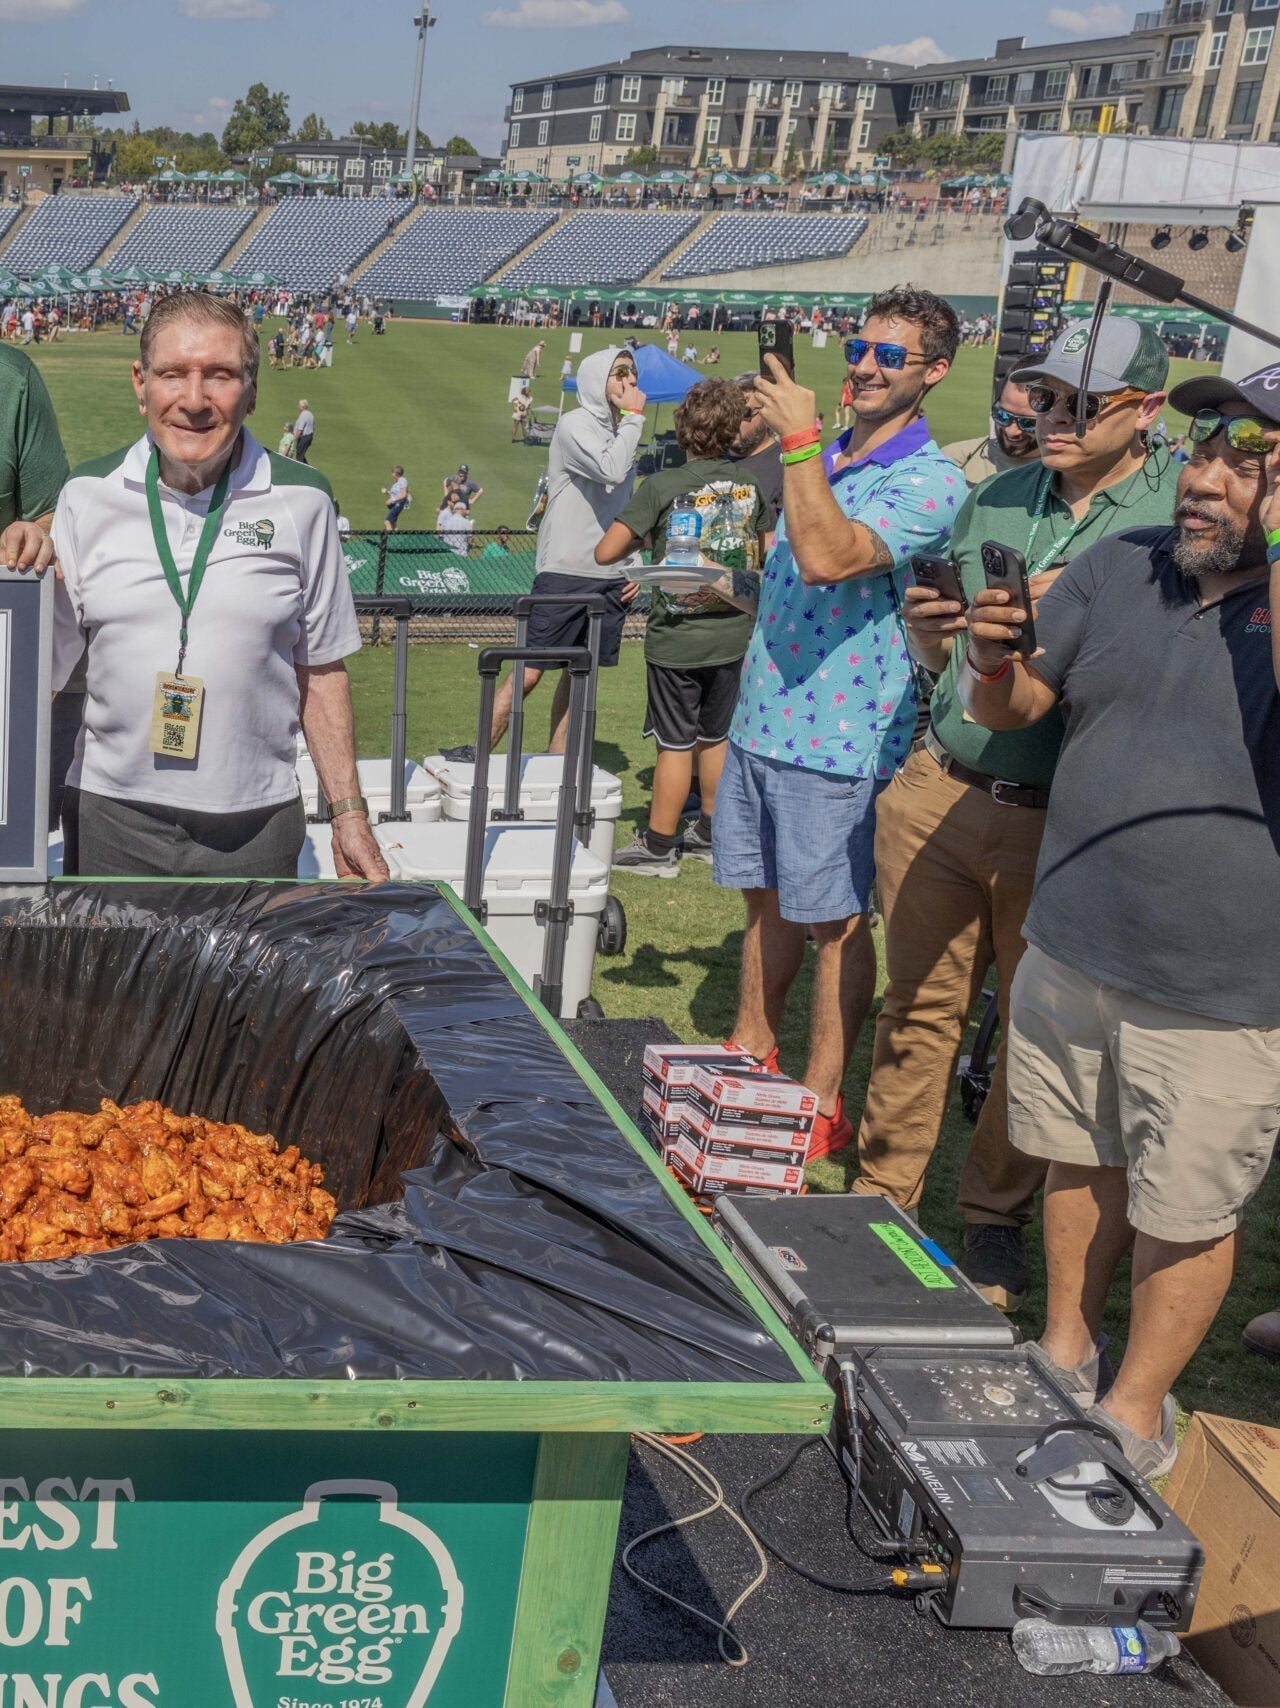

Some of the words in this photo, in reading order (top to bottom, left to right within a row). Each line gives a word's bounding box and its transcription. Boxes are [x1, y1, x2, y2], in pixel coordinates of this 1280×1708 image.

[238, 522, 256, 531] Big
[224, 529, 256, 538] Green
[236, 535, 257, 546] Egg
[1038, 548, 1057, 569] Green
[416, 570, 442, 580] Big
[400, 577, 446, 588] Green
[915, 1463, 954, 1504] JAVELIN
[293, 1550, 394, 1602] Big
[247, 1591, 430, 1635] Green
[276, 1635, 394, 1685] Egg
[340, 1696, 383, 1708] 1974
